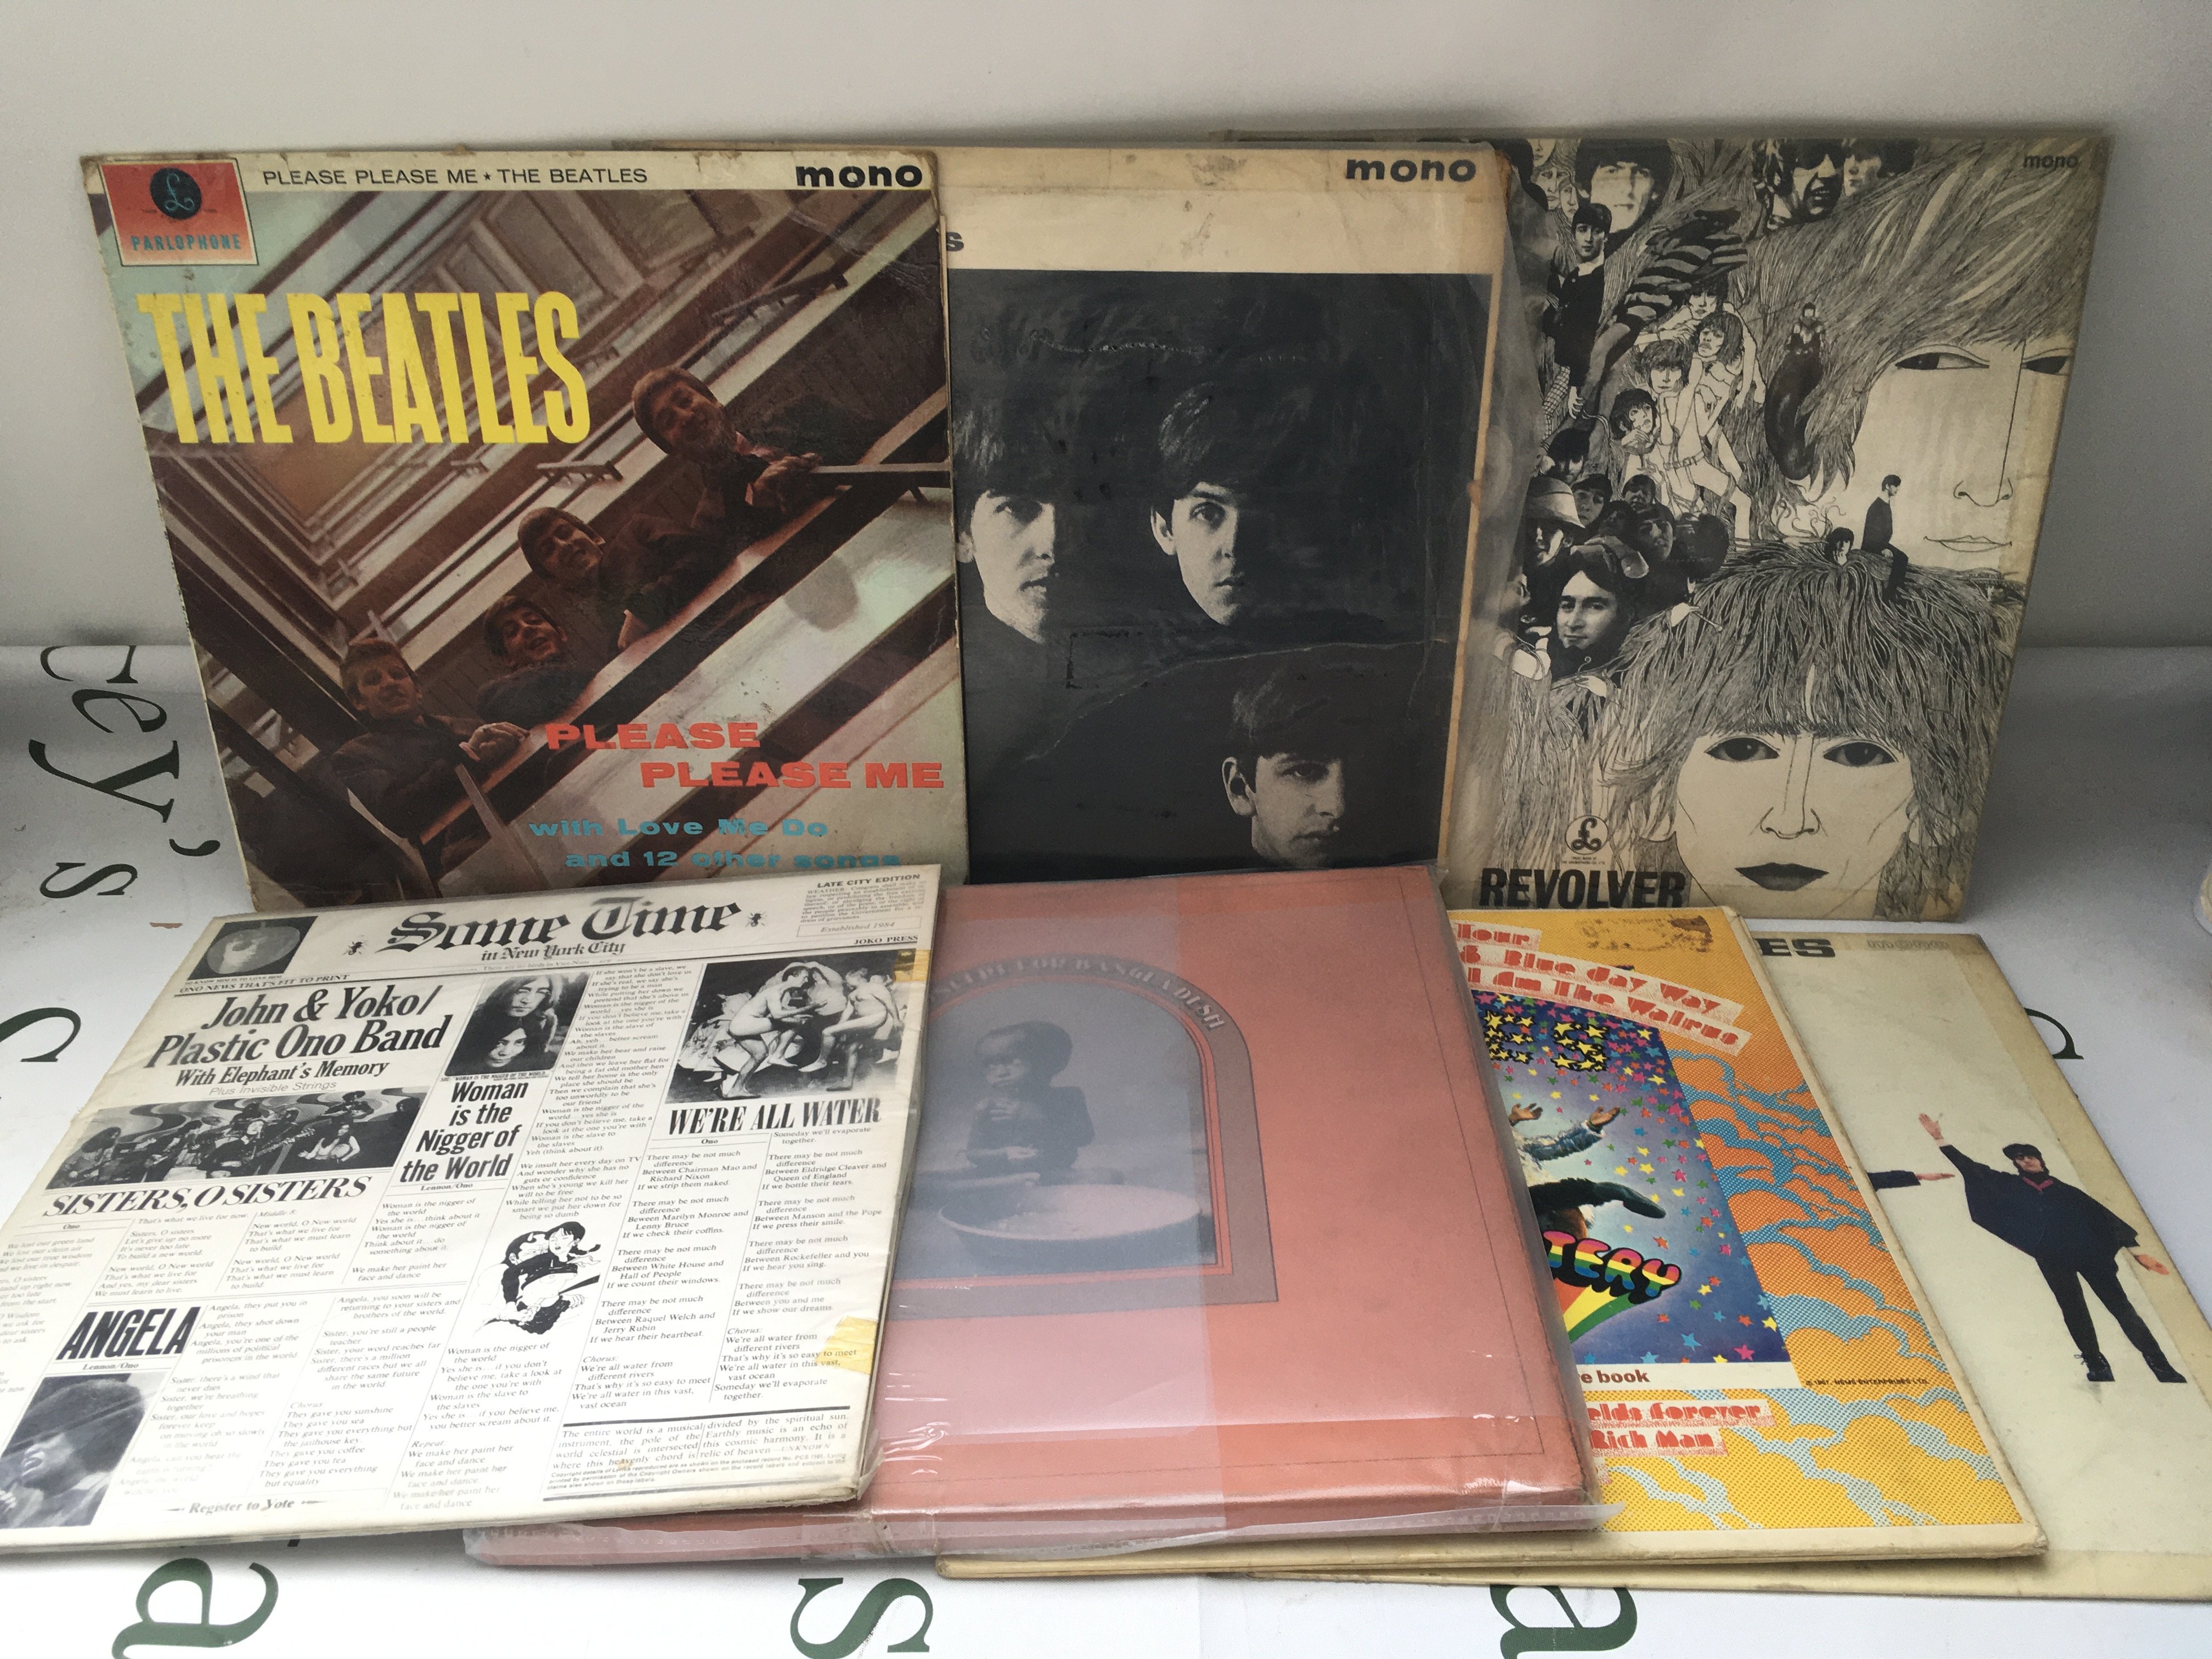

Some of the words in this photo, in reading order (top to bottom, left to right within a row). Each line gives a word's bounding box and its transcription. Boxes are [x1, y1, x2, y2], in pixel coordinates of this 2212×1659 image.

[1346, 157, 1476, 183] mono
[2023, 154, 2079, 169] mono
[263, 170, 347, 185] PLEASE
[355, 170, 438, 184] PLEASE
[448, 169, 477, 184] ME
[497, 168, 541, 184] THE
[549, 168, 648, 183] BEATLES
[796, 164, 923, 188] mono
[131, 234, 241, 251] PARLOPHONE
[136, 292, 294, 444] THE
[286, 291, 591, 444] BEATLES
[545, 722, 760, 751] PLEASE
[640, 761, 851, 789] PLEASE
[865, 762, 944, 788] ME
[528, 819, 603, 837] with
[618, 819, 704, 836] Love
[718, 819, 769, 836] Me
[783, 819, 828, 837] Do
[566, 851, 630, 868] and
[643, 851, 678, 867] 12
[696, 850, 780, 868] other
[794, 854, 901, 869] songs
[817, 881, 844, 889] LATE
[875, 874, 921, 884] EDITION
[1479, 867, 1686, 909] REVOLVER
[374, 911, 571, 953] Some
[581, 896, 742, 941] Time
[1455, 923, 1530, 945] Tour
[481, 950, 499, 961] in
[500, 946, 539, 961] New
[543, 944, 585, 961] York
[588, 941, 626, 955] City
[1503, 949, 1576, 974] Blue
[1586, 967, 1649, 994] day
[1660, 983, 1721, 1015] Way
[201, 994, 290, 1031] John
[291, 988, 329, 1023] &
[334, 985, 444, 1022] Yoko/
[1552, 979, 1615, 1006] The
[1627, 997, 1740, 1045] Walrus
[143, 1029, 270, 1069] Plastic
[274, 1024, 348, 1059] Ono
[349, 1014, 454, 1055] Band
[174, 1068, 218, 1088] With
[218, 1061, 313, 1087] Elephant's
[317, 1060, 391, 1079] Memory
[209, 1086, 237, 1096] Plus
[239, 1083, 290, 1094] Invisible
[292, 1080, 337, 1093] Strings
[451, 1081, 529, 1103] Woman
[449, 1105, 471, 1126] is
[475, 1103, 513, 1125] the
[669, 1106, 747, 1135] WE'RE
[750, 1102, 795, 1130] ALL
[802, 1097, 882, 1127] WATER
[415, 1128, 494, 1155] Nigger
[494, 1124, 523, 1148] of
[399, 1159, 439, 1183] the
[445, 1153, 514, 1180] World
[194, 1186, 225, 1208] O
[221, 1176, 373, 1205] SISTERS
[55, 1306, 201, 1361] ANGELA
[407, 1324, 436, 1334] people
[1596, 1369, 1650, 1383] book
[707, 1419, 742, 1429] divided
[748, 1419, 759, 1427] by
[786, 1414, 823, 1424] spiritual
[1650, 1402, 1761, 1420] forever
[1591, 1430, 1648, 1449] Rich
[1656, 1430, 1714, 1448] Man
[188, 1502, 242, 1515] Register
[246, 1502, 259, 1511] to
[265, 1498, 295, 1510] Vote
